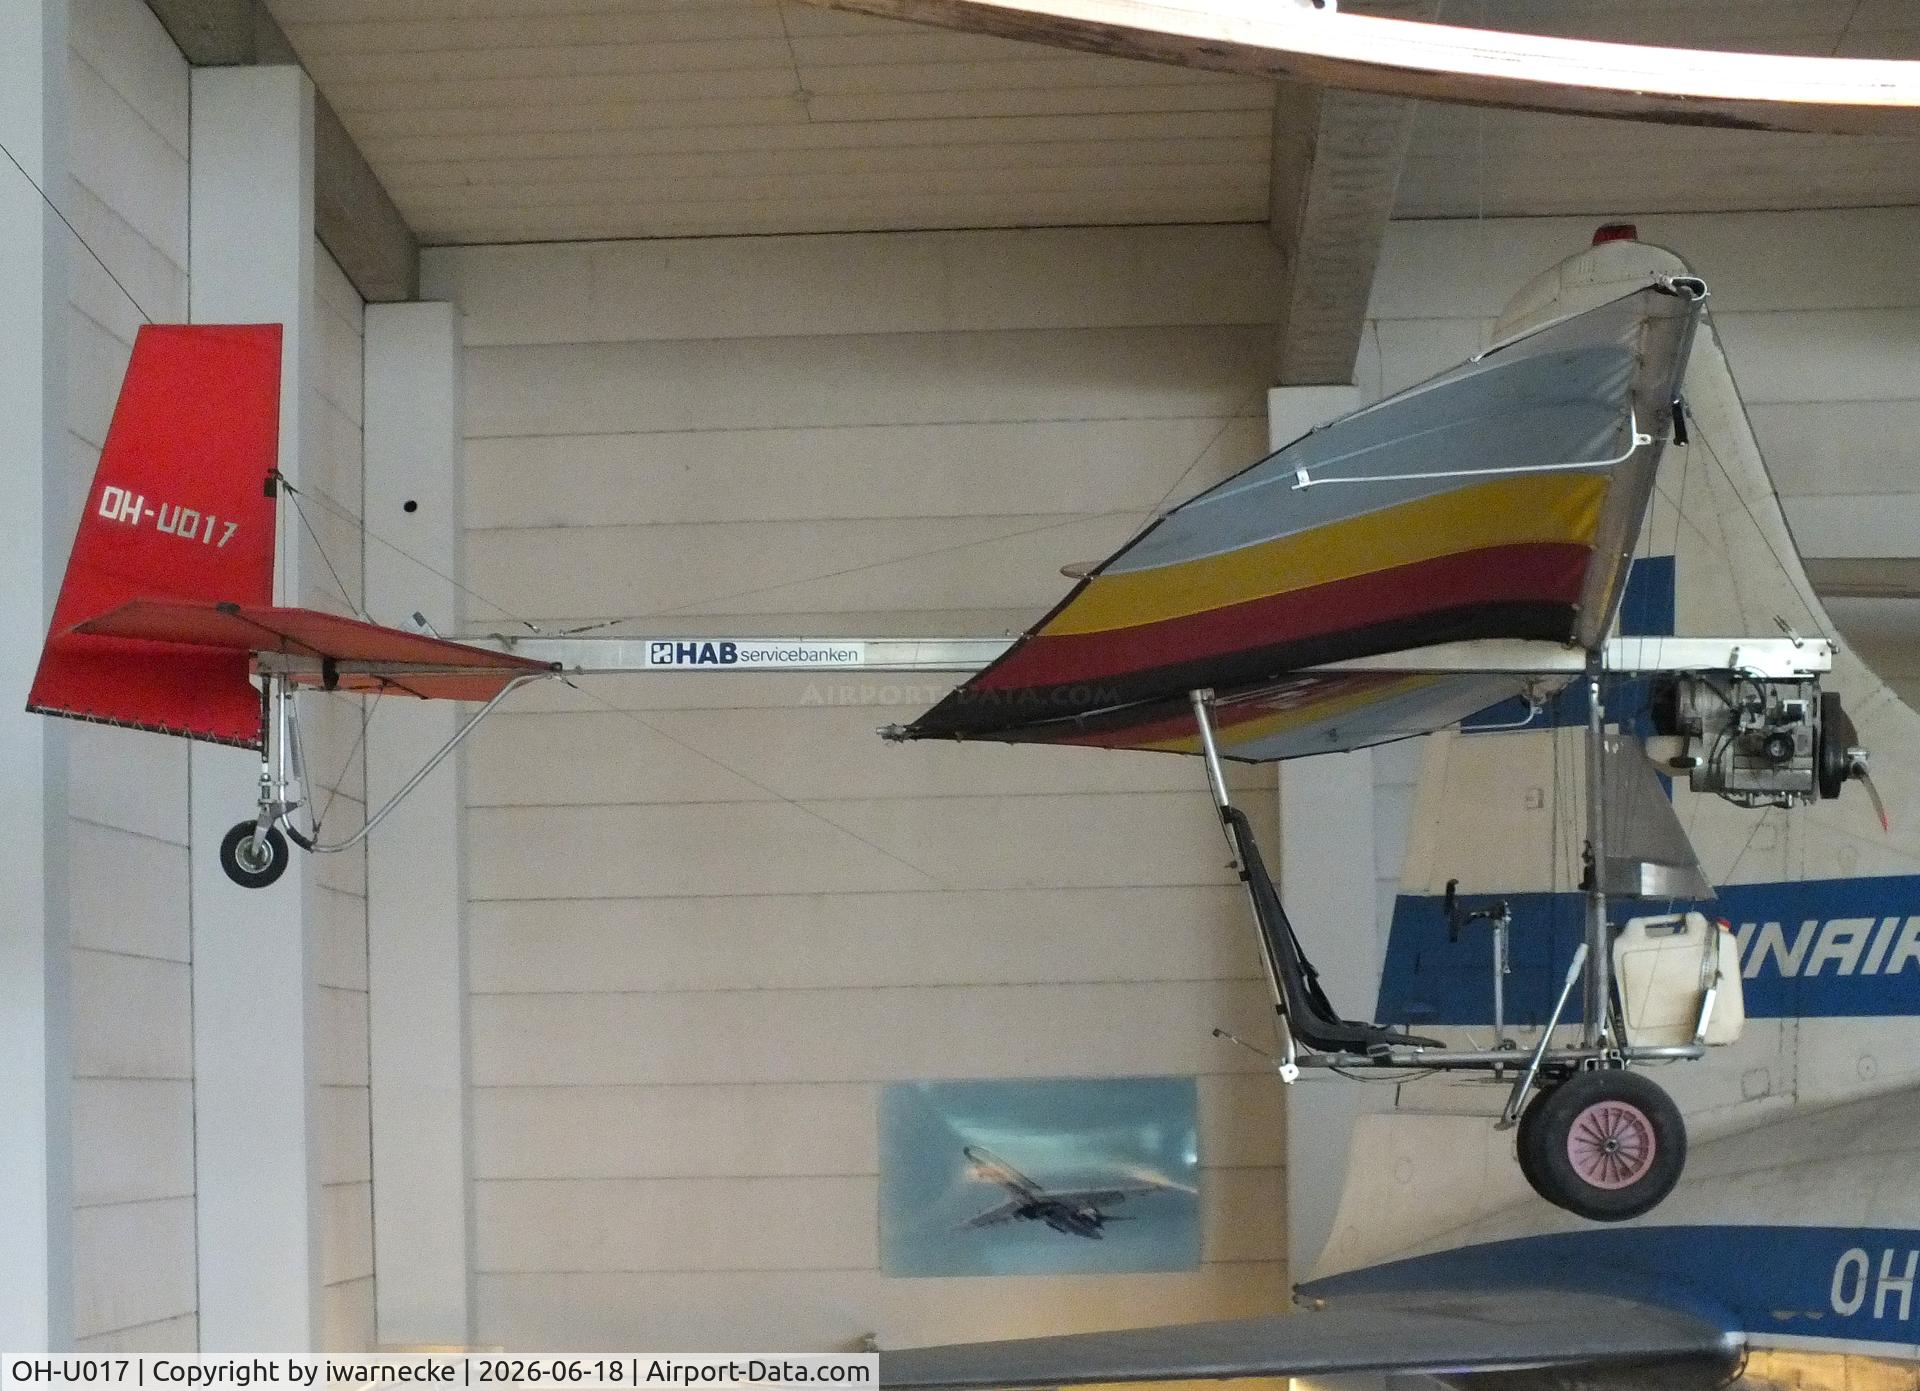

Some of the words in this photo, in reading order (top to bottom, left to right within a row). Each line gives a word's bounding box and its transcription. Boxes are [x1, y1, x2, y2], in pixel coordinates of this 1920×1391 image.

[98, 485, 239, 548] OH-U017
[676, 642, 738, 664] HAB
[740, 646, 858, 662] servicebanken
[1830, 1247, 1920, 1321] OH
